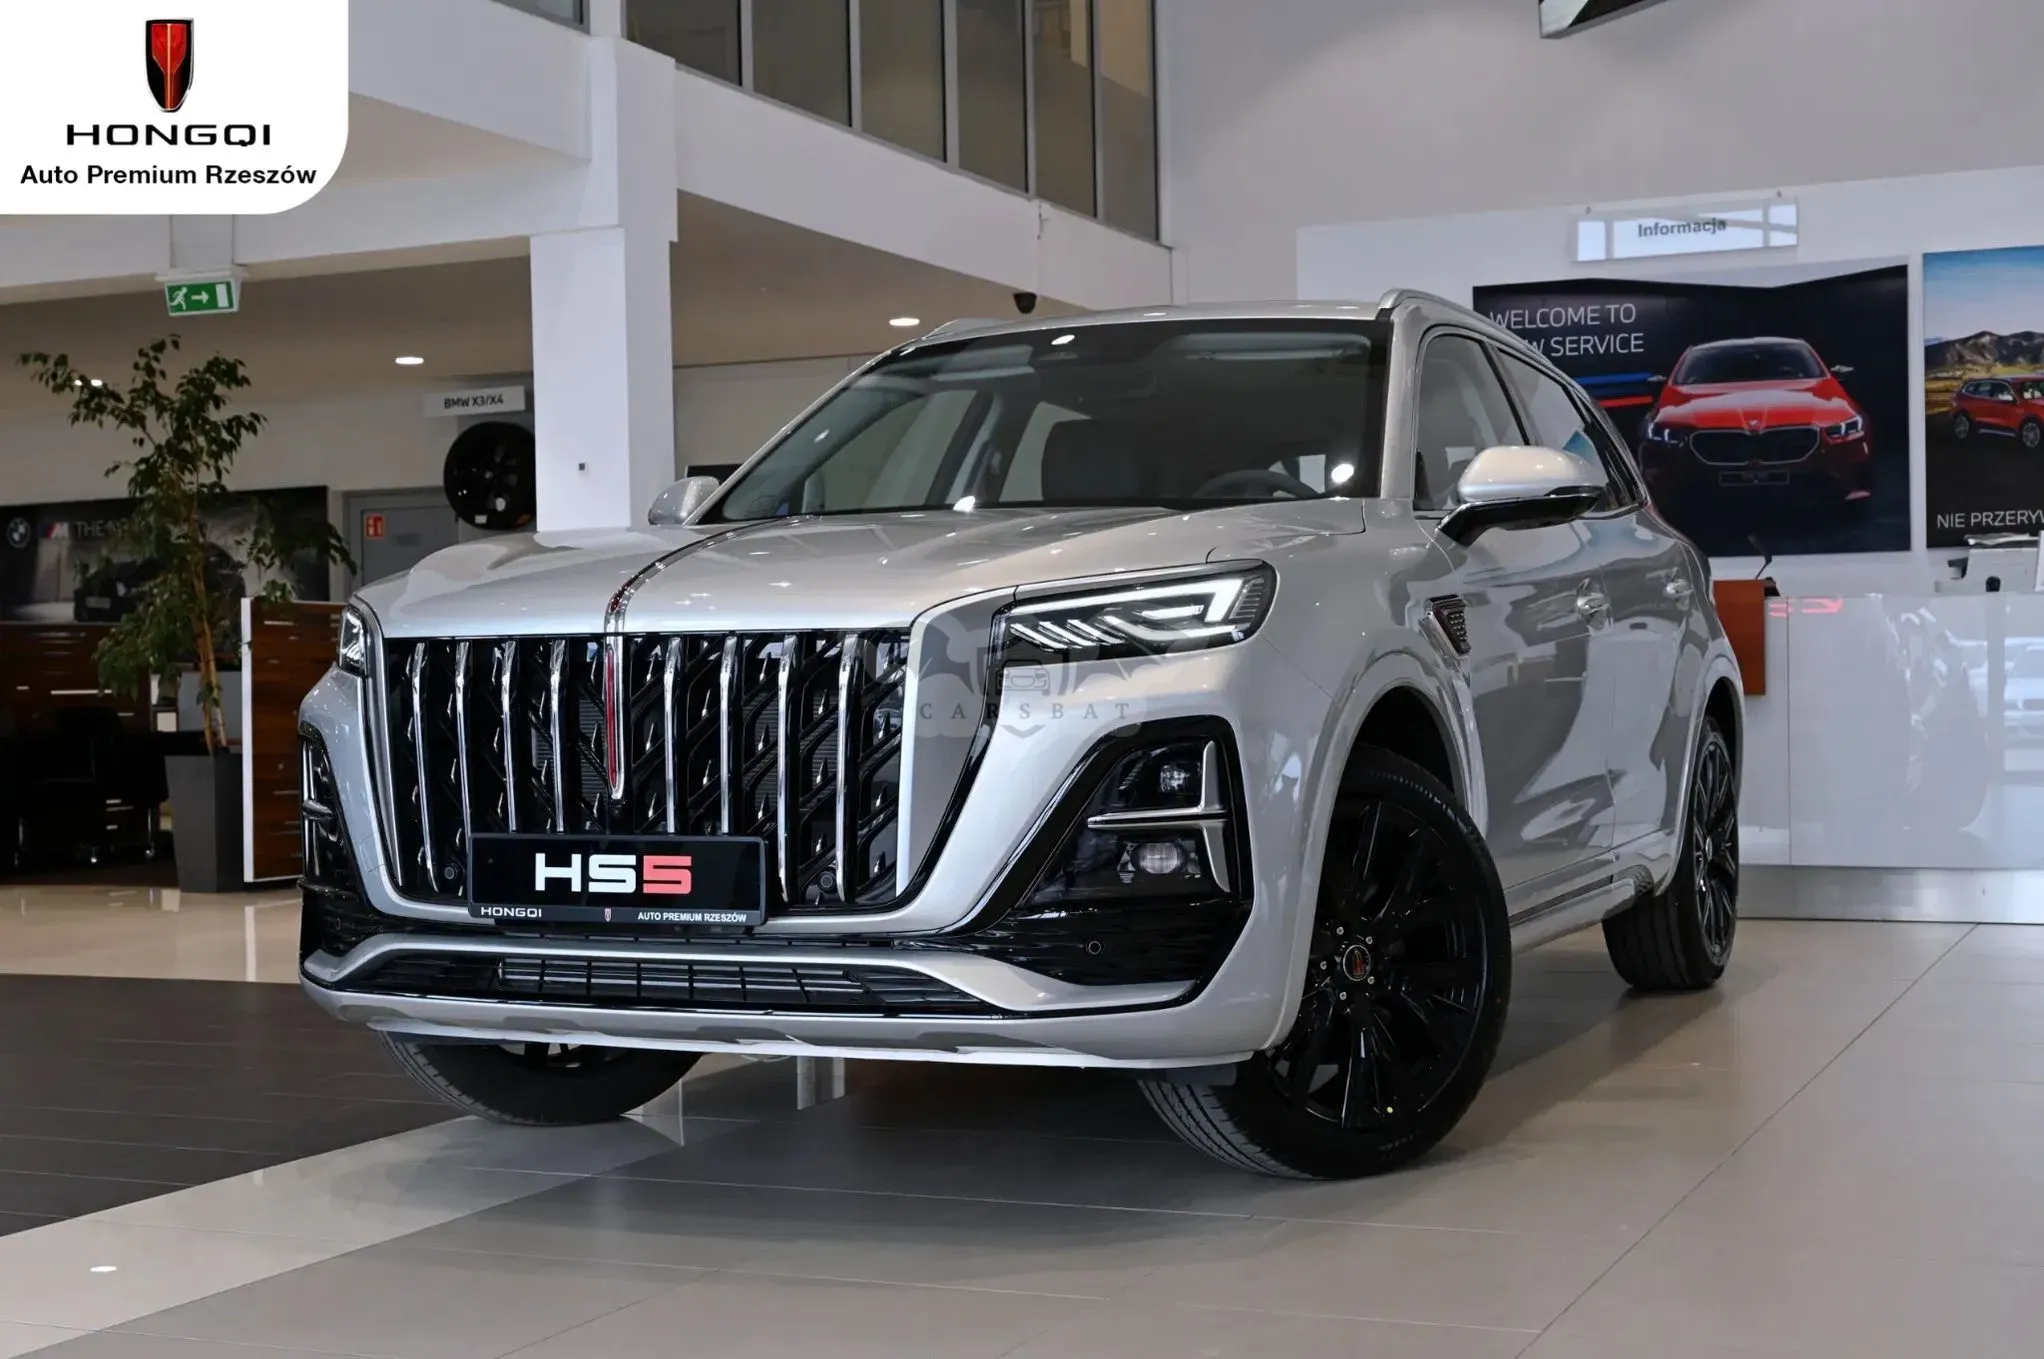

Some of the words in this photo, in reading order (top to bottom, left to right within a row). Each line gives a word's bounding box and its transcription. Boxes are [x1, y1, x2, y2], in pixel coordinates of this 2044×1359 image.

[1637, 217, 1728, 238] Informacja
[1489, 305, 1601, 330] WELCOME
[1605, 303, 1637, 324] TO
[1550, 333, 1645, 358] SERVICE
[443, 396, 470, 409] BMW
[472, 393, 504, 408] X3/X4
[75, 520, 105, 538] THE
[1936, 513, 1966, 529] NIE
[534, 852, 693, 895] HS5
[480, 906, 543, 918] HONGQI
[637, 911, 662, 921] AUTO
[663, 912, 703, 922] PREMIUM
[704, 911, 748, 923] RZESZÓW
